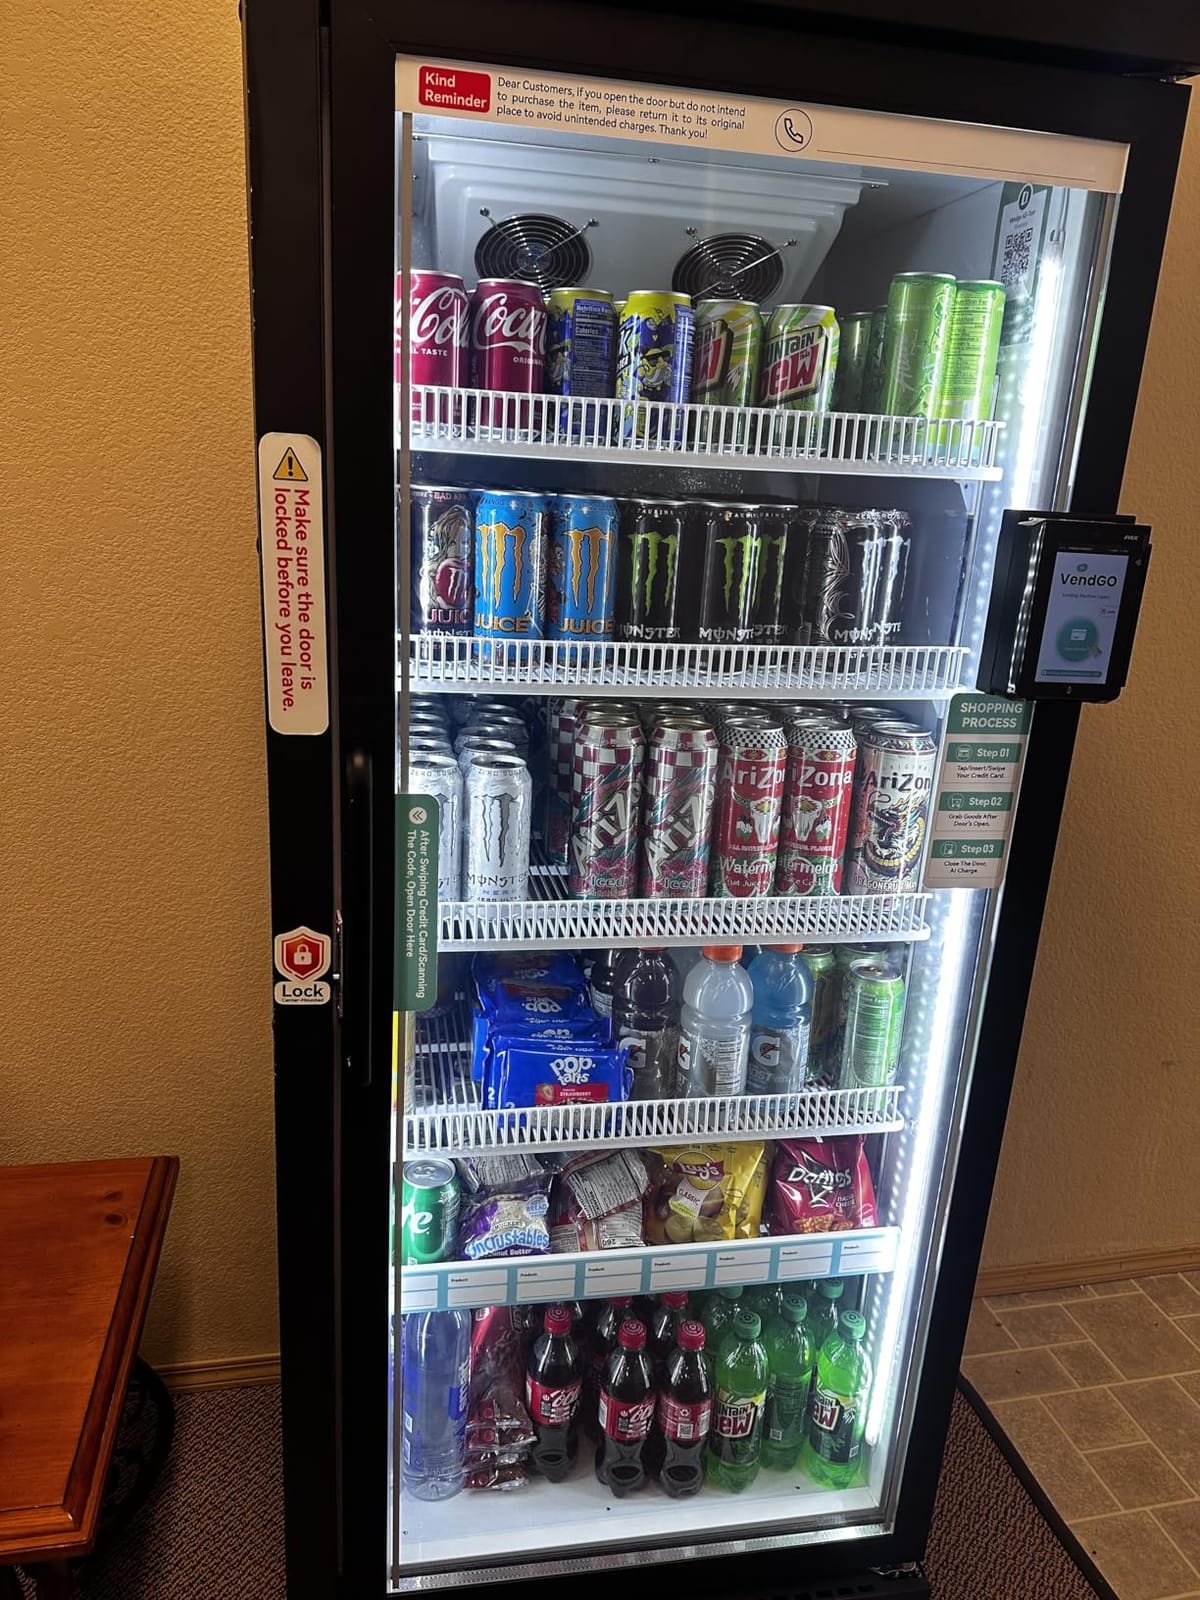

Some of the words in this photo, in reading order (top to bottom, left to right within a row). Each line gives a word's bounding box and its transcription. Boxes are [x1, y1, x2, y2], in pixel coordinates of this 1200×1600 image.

[425, 72, 456, 88] Kind
[425, 89, 487, 108] Reminder
[498, 77, 520, 89] Dear
[522, 80, 575, 97] Customers,
[577, 87, 584, 98] if
[585, 90, 601, 100] you
[604, 93, 627, 104] open
[629, 94, 644, 105] the
[646, 96, 667, 108] door
[669, 98, 685, 110] but
[686, 100, 698, 112] do
[700, 103, 715, 114] not
[717, 104, 746, 117] intend
[496, 105, 522, 117] place
[524, 108, 534, 118] to
[536, 111, 562, 122] avoid
[565, 114, 617, 128] unintended
[619, 119, 657, 133] charges.
[659, 124, 687, 136] Thank
[688, 128, 709, 139] you!
[497, 92, 507, 101] to
[512, 94, 554, 107] purchase
[559, 99, 574, 109] the
[578, 102, 602, 114] item,
[606, 105, 636, 117] please
[639, 109, 668, 121] return
[672, 111, 679, 122] it
[682, 113, 692, 124] to
[696, 114, 707, 125] its
[711, 118, 745, 131] original
[421, 348, 448, 357] TASTE
[275, 487, 293, 550] locked
[294, 489, 311, 541] Make
[296, 548, 308, 586] sure
[277, 557, 294, 617] before
[1061, 573, 1117, 587] VendGO
[298, 592, 314, 623] the
[425, 609, 470, 624] JUIC
[475, 614, 529, 632] JUICE
[559, 618, 614, 634] JUICE
[275, 622, 294, 656] you
[300, 628, 314, 672] door
[281, 661, 297, 711] leave.
[301, 676, 316, 690] is
[960, 703, 1023, 713] SHOPPING
[962, 718, 1017, 728] PROCESS
[977, 748, 998, 759] Step
[1000, 748, 1010, 757] 01
[969, 797, 990, 807] Step
[991, 797, 1002, 806] 02
[407, 830, 416, 848] The
[419, 830, 429, 856] After
[961, 845, 982, 855] Step
[983, 844, 994, 853] 03
[406, 850, 416, 878] Code,
[417, 858, 429, 896] Swiping
[406, 882, 416, 906] Open
[406, 908, 415, 932] Door
[418, 900, 428, 928] Credit
[406, 935, 415, 957] Here
[416, 930, 428, 998] Card/Scanning
[283, 984, 324, 997] Lock
[678, 1162, 720, 1180] Lay's
[788, 1167, 851, 1187] Doritos
[679, 1189, 701, 1205] CLASSIC
[465, 1229, 549, 1258] Uncrustables
